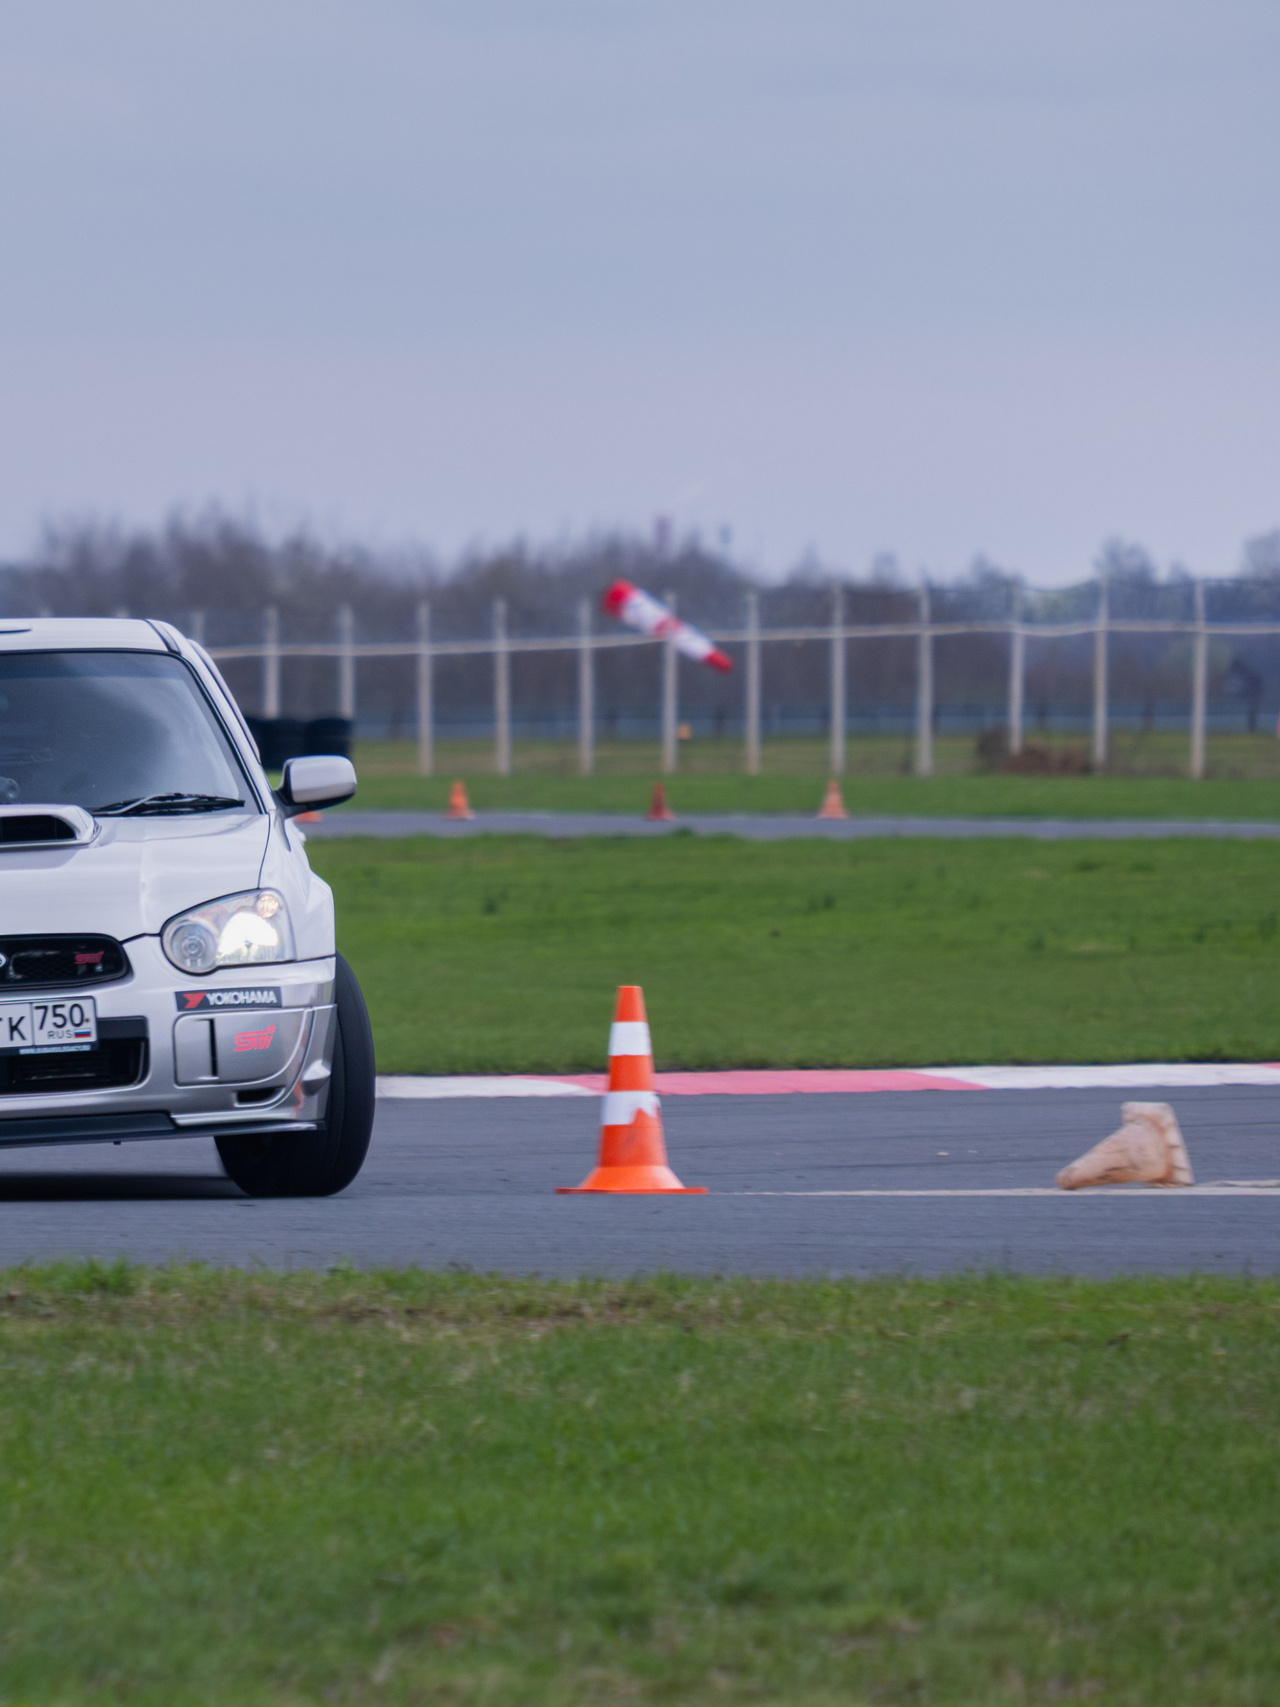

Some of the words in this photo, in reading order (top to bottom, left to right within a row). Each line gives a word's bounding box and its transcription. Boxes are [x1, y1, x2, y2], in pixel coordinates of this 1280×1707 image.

[206, 990, 277, 1006] YOKOHAMA
[34, 1003, 84, 1030] 750
[47, 1029, 73, 1039] RUS
